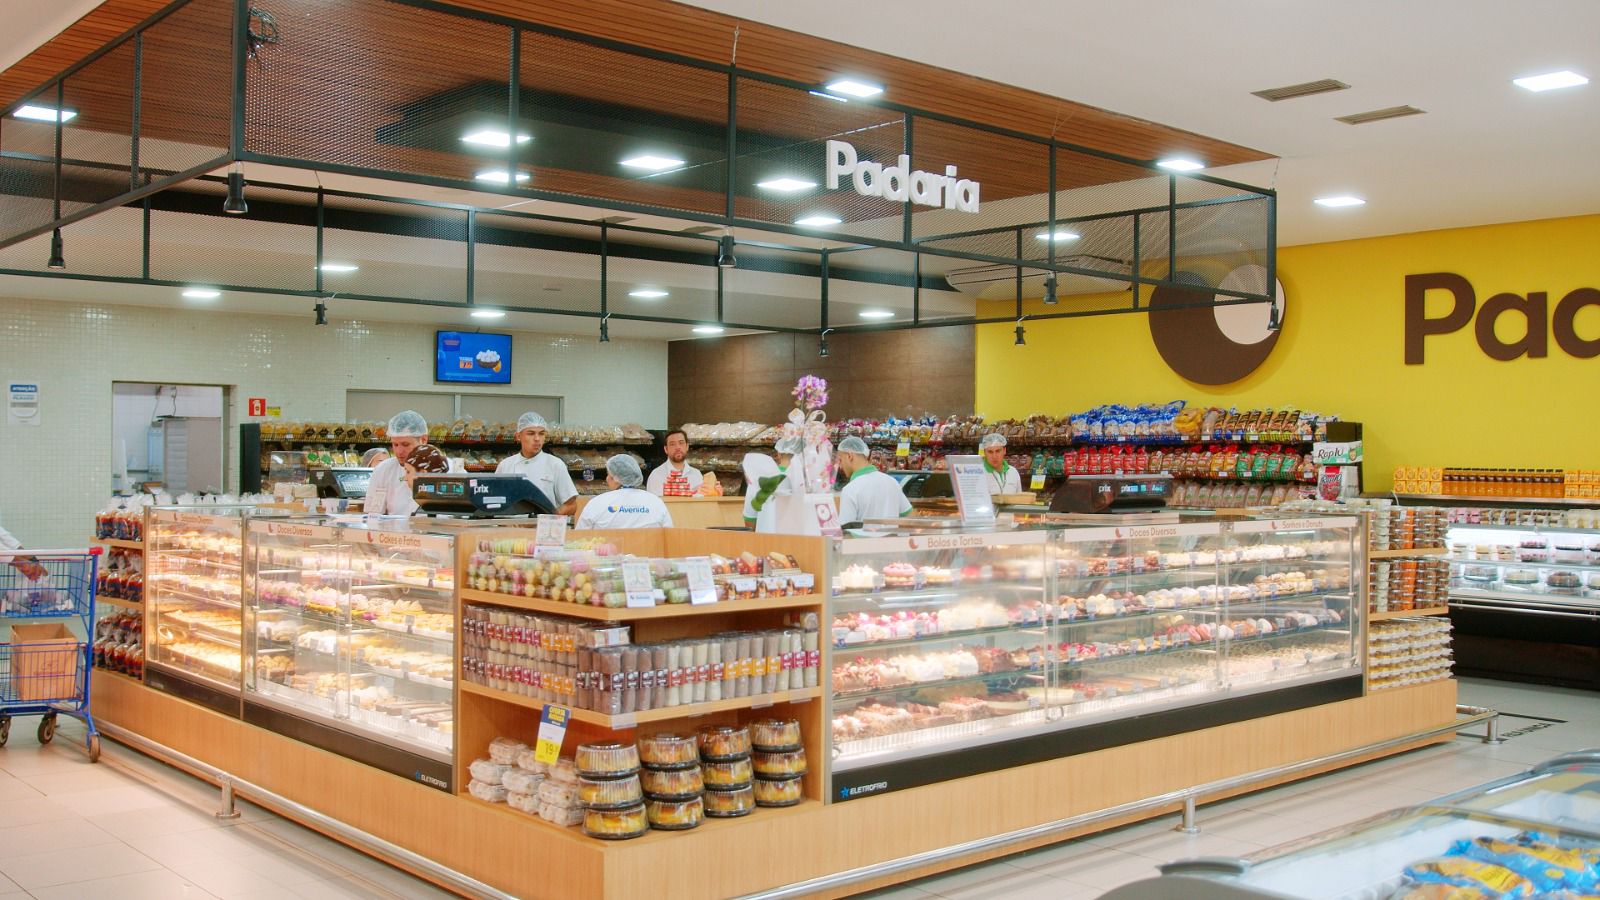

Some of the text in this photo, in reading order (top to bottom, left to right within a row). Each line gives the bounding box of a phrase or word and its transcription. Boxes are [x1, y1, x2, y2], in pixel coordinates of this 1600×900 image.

[826, 139, 980, 214] Padaria
[473, 484, 489, 494] prix
[618, 505, 650, 513] Avenida
[849, 781, 888, 795] ELETROFRIO
